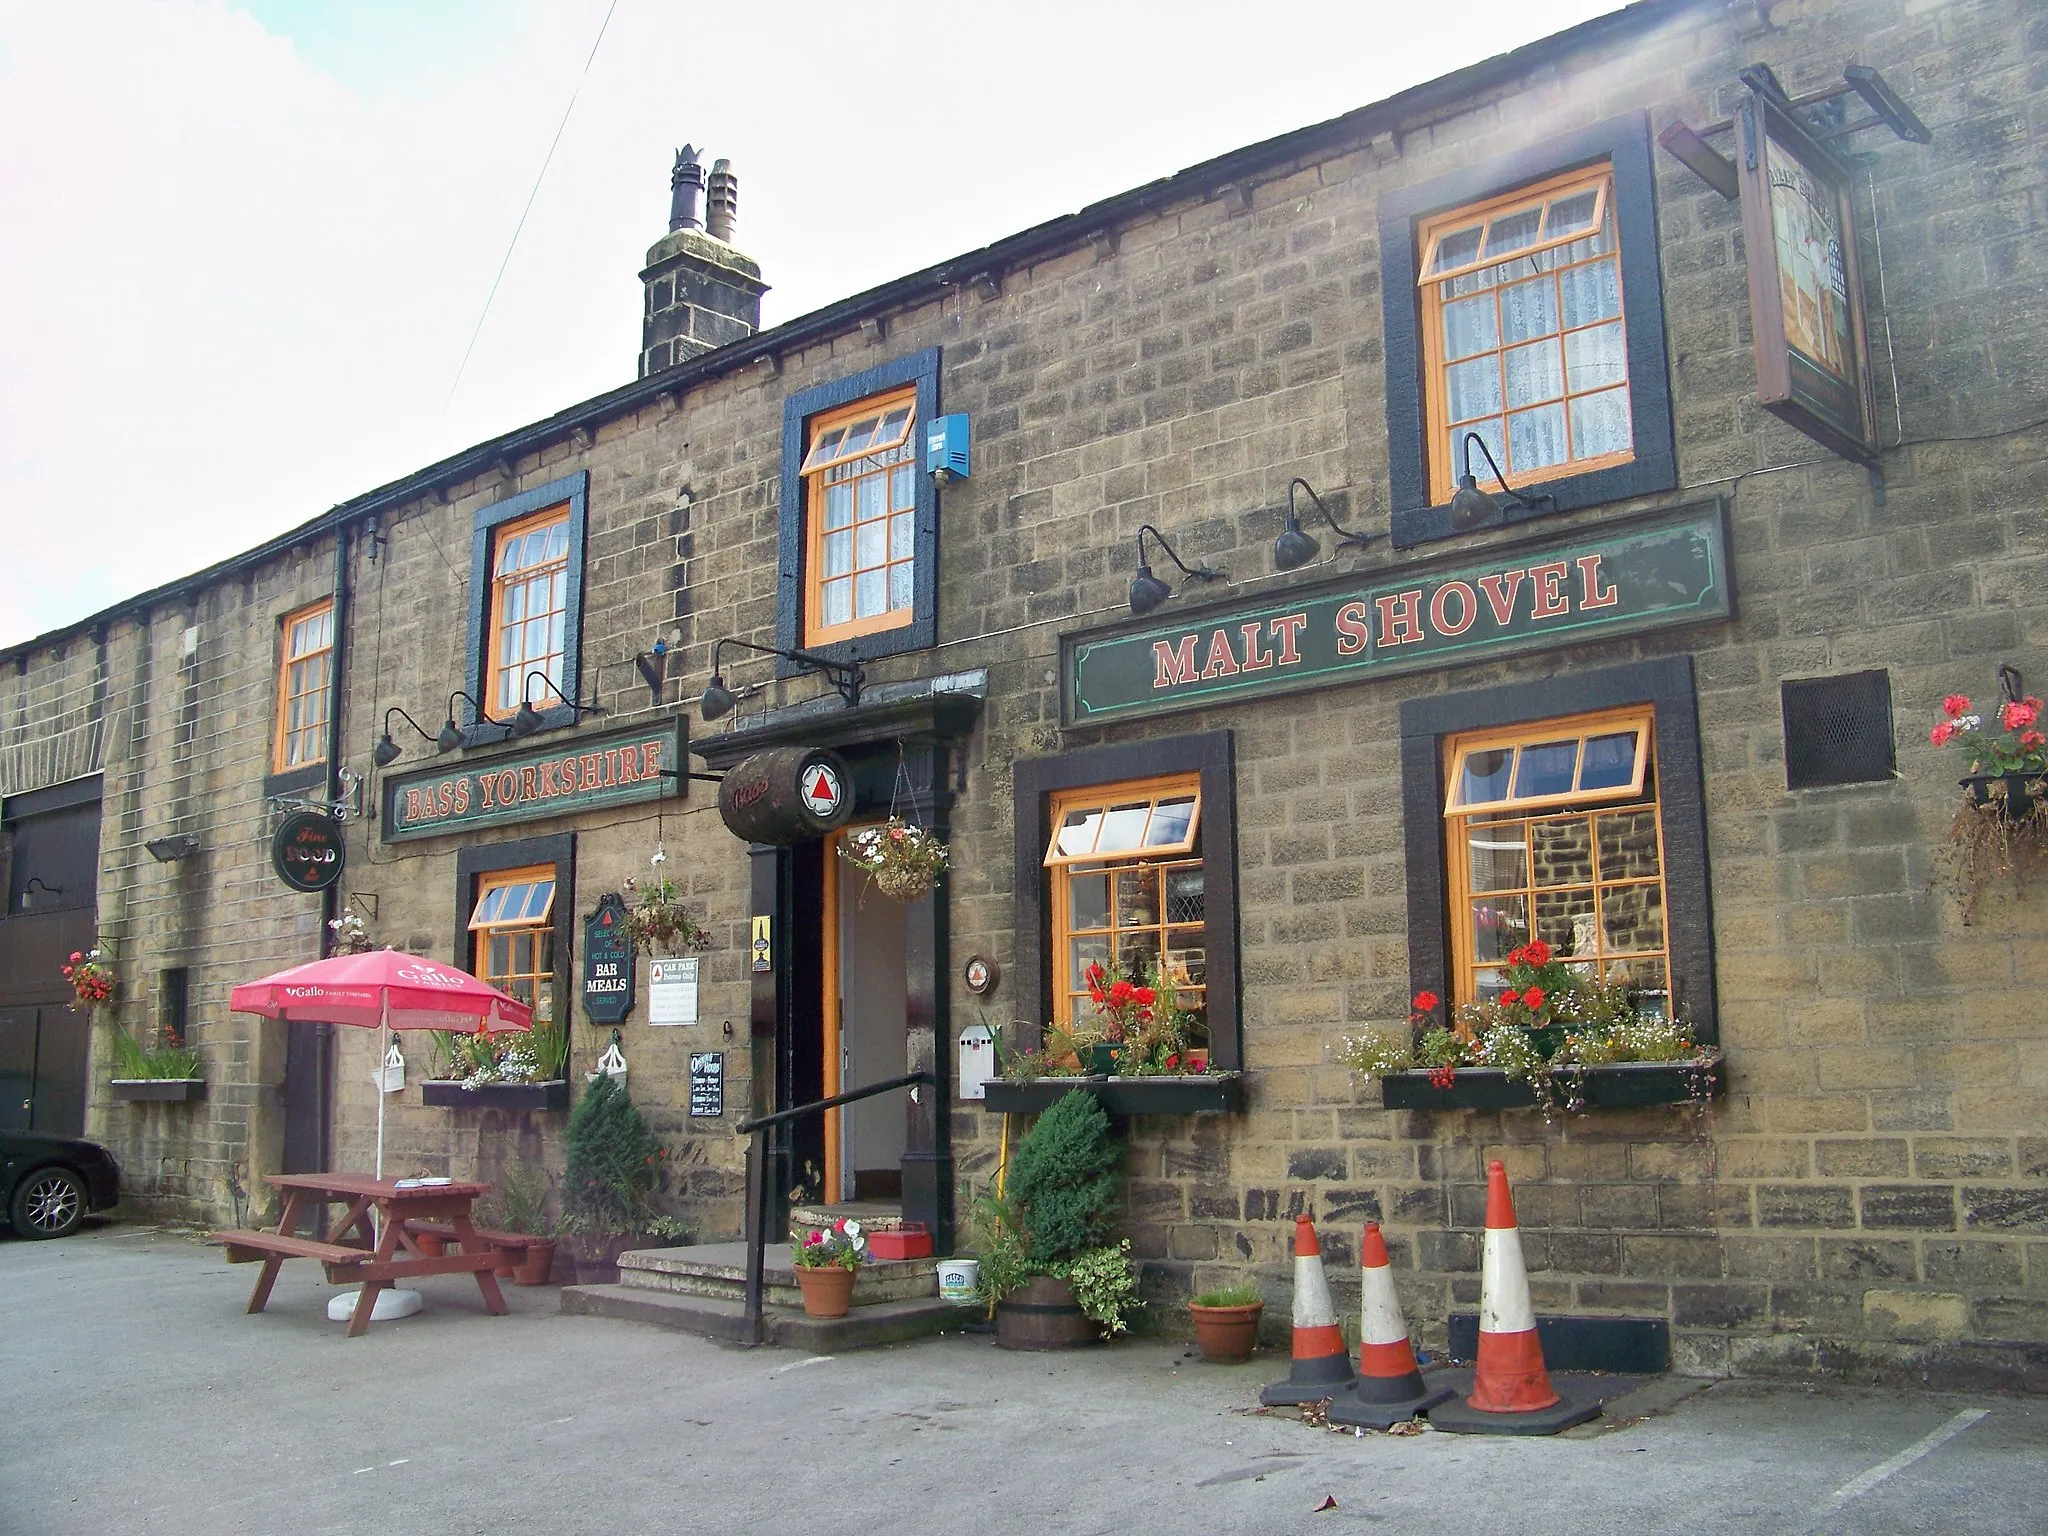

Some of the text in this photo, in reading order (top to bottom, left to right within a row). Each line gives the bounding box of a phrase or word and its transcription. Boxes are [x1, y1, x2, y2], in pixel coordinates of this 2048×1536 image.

[1152, 554, 1618, 688] MALT SHOVEL
[406, 741, 661, 821] BASS YORKSHIRE
[592, 952, 602, 960] HOT
[610, 951, 625, 959] COLD
[595, 963, 618, 977] BAR
[663, 962, 696, 971] CAR PARK
[397, 969, 465, 985] Gallo
[296, 985, 324, 997] Gallo
[586, 978, 627, 993] MEALS
[596, 996, 617, 1005] SERVED
